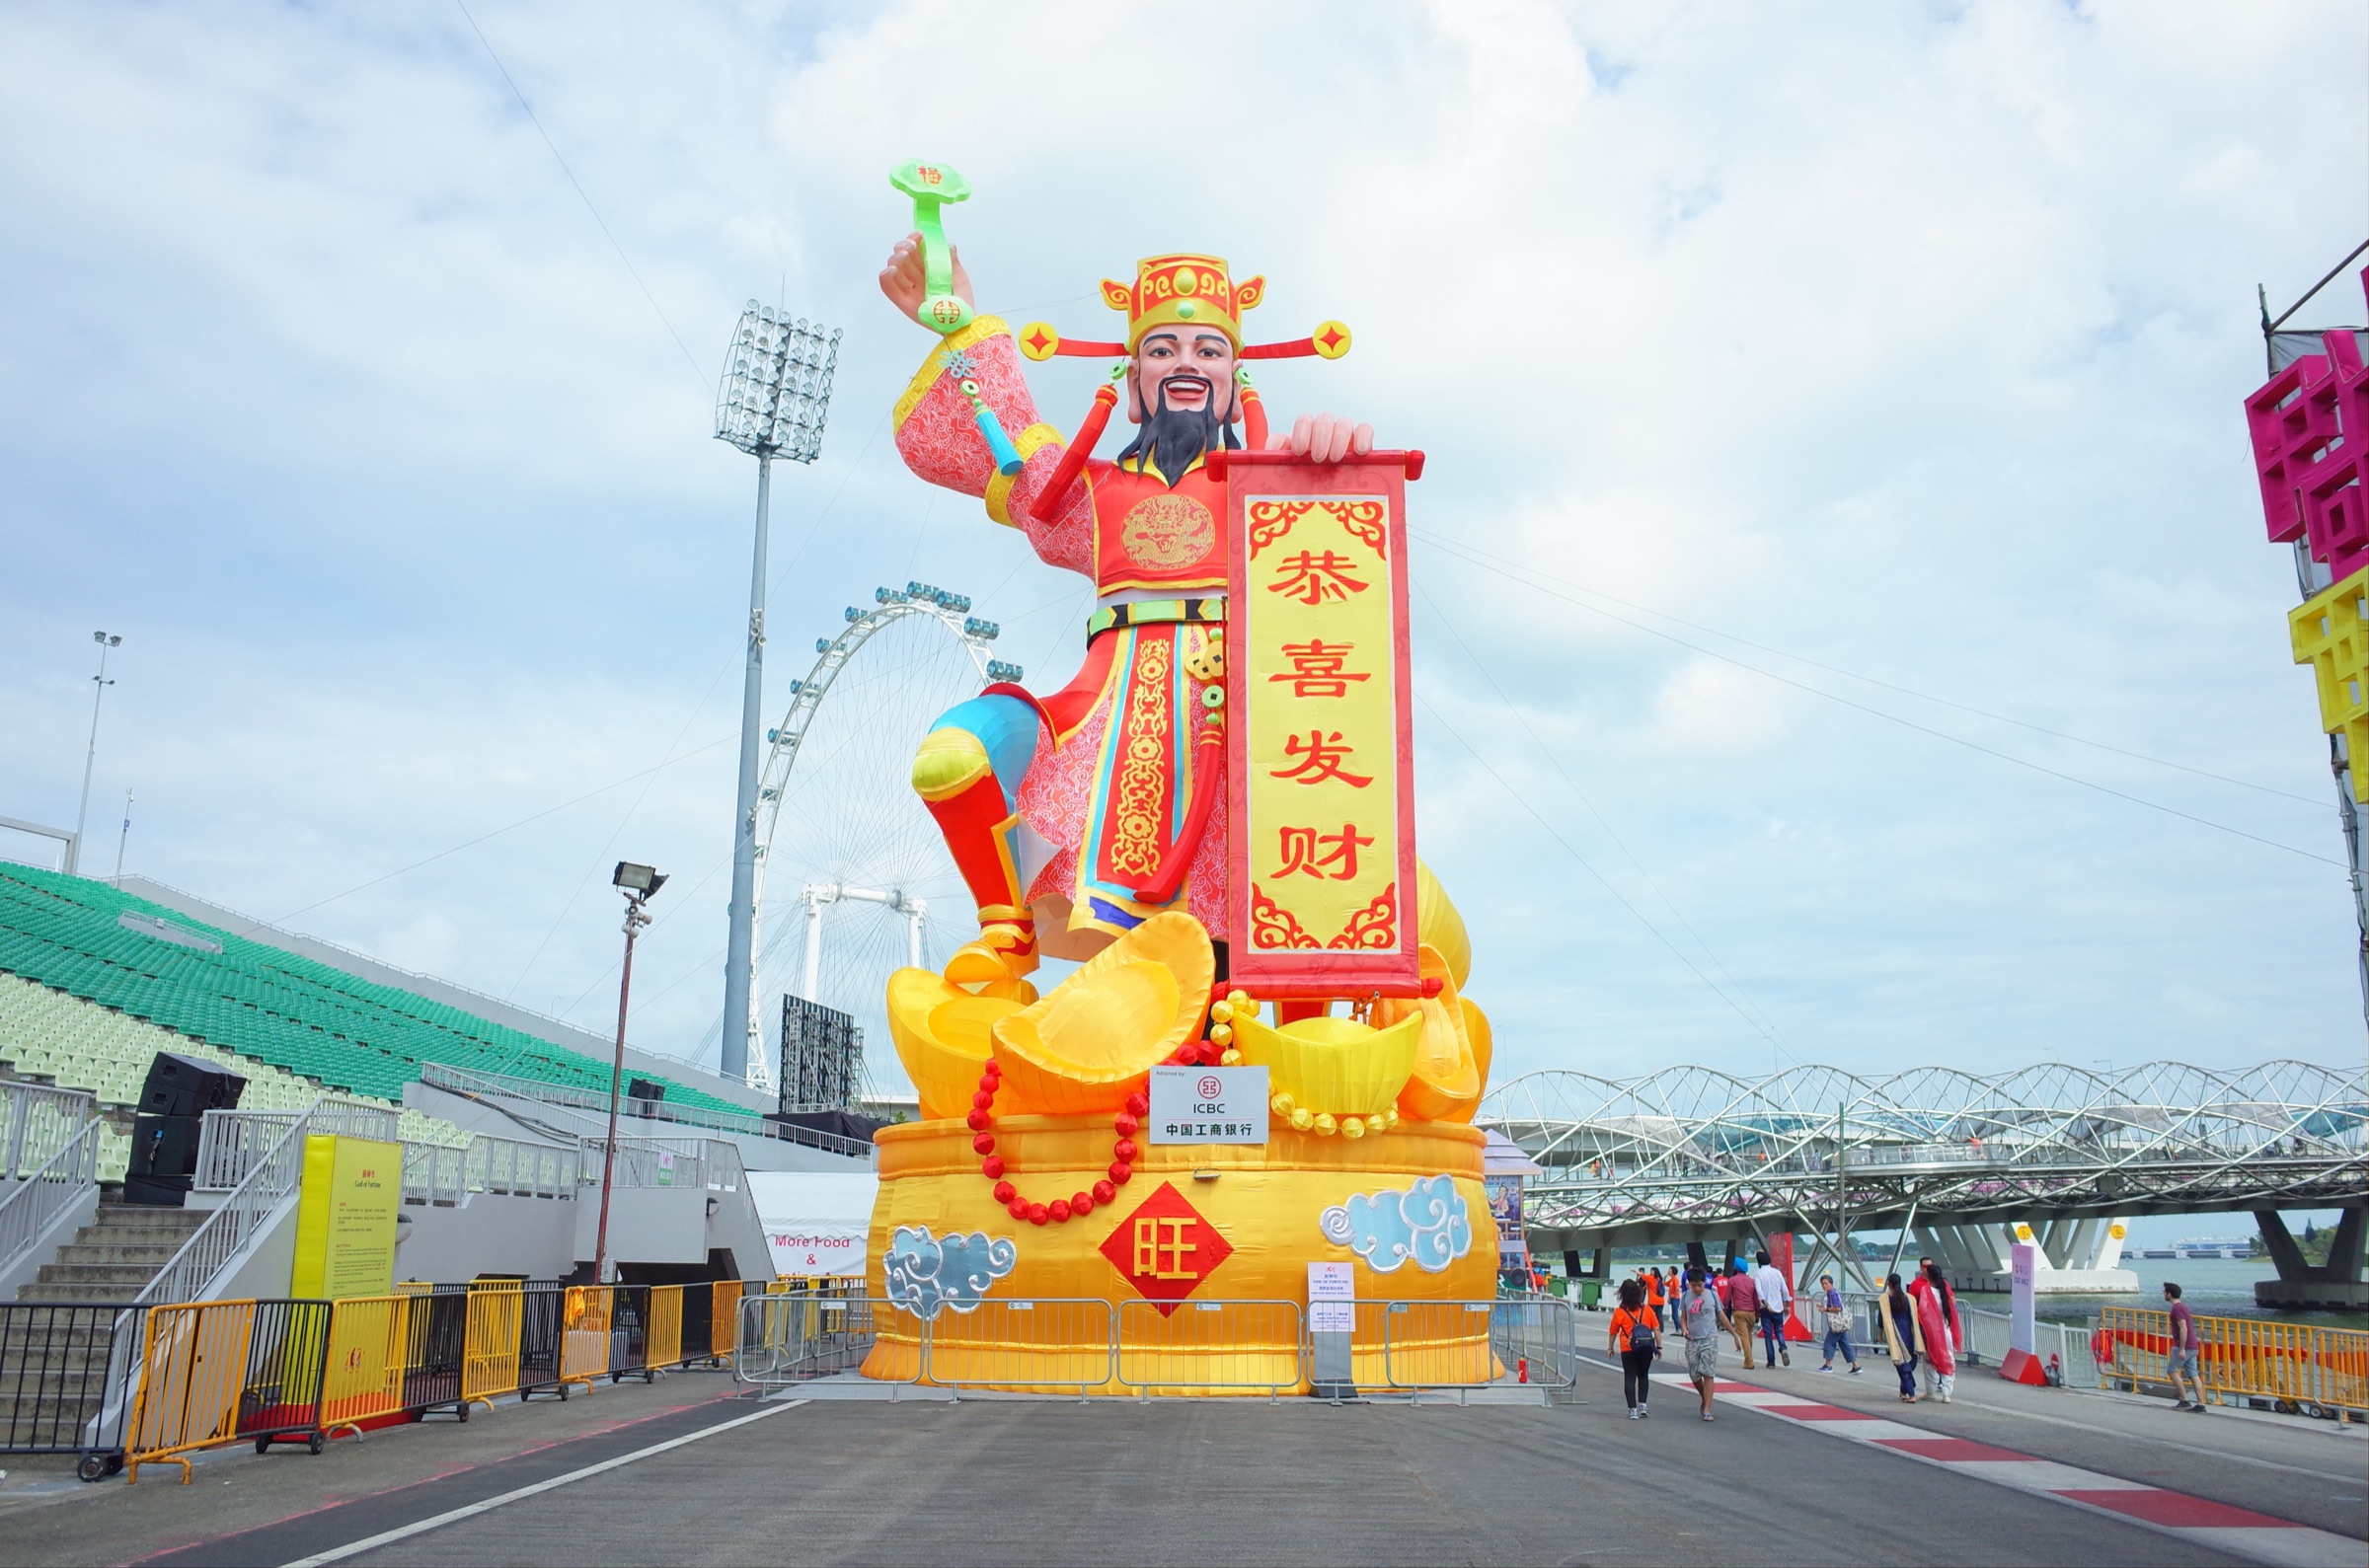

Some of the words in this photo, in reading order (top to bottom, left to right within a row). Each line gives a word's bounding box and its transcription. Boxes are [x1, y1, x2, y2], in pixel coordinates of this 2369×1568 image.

[1267, 549, 1375, 881] 恭喜发财
[1193, 1103, 1225, 1113] ICBC
[1166, 1123, 1253, 1136] 中国工商银行
[775, 1234, 809, 1247] More
[814, 1235, 850, 1248] Food
[1133, 1217, 1198, 1280] 旺
[806, 1253, 816, 1265] &
